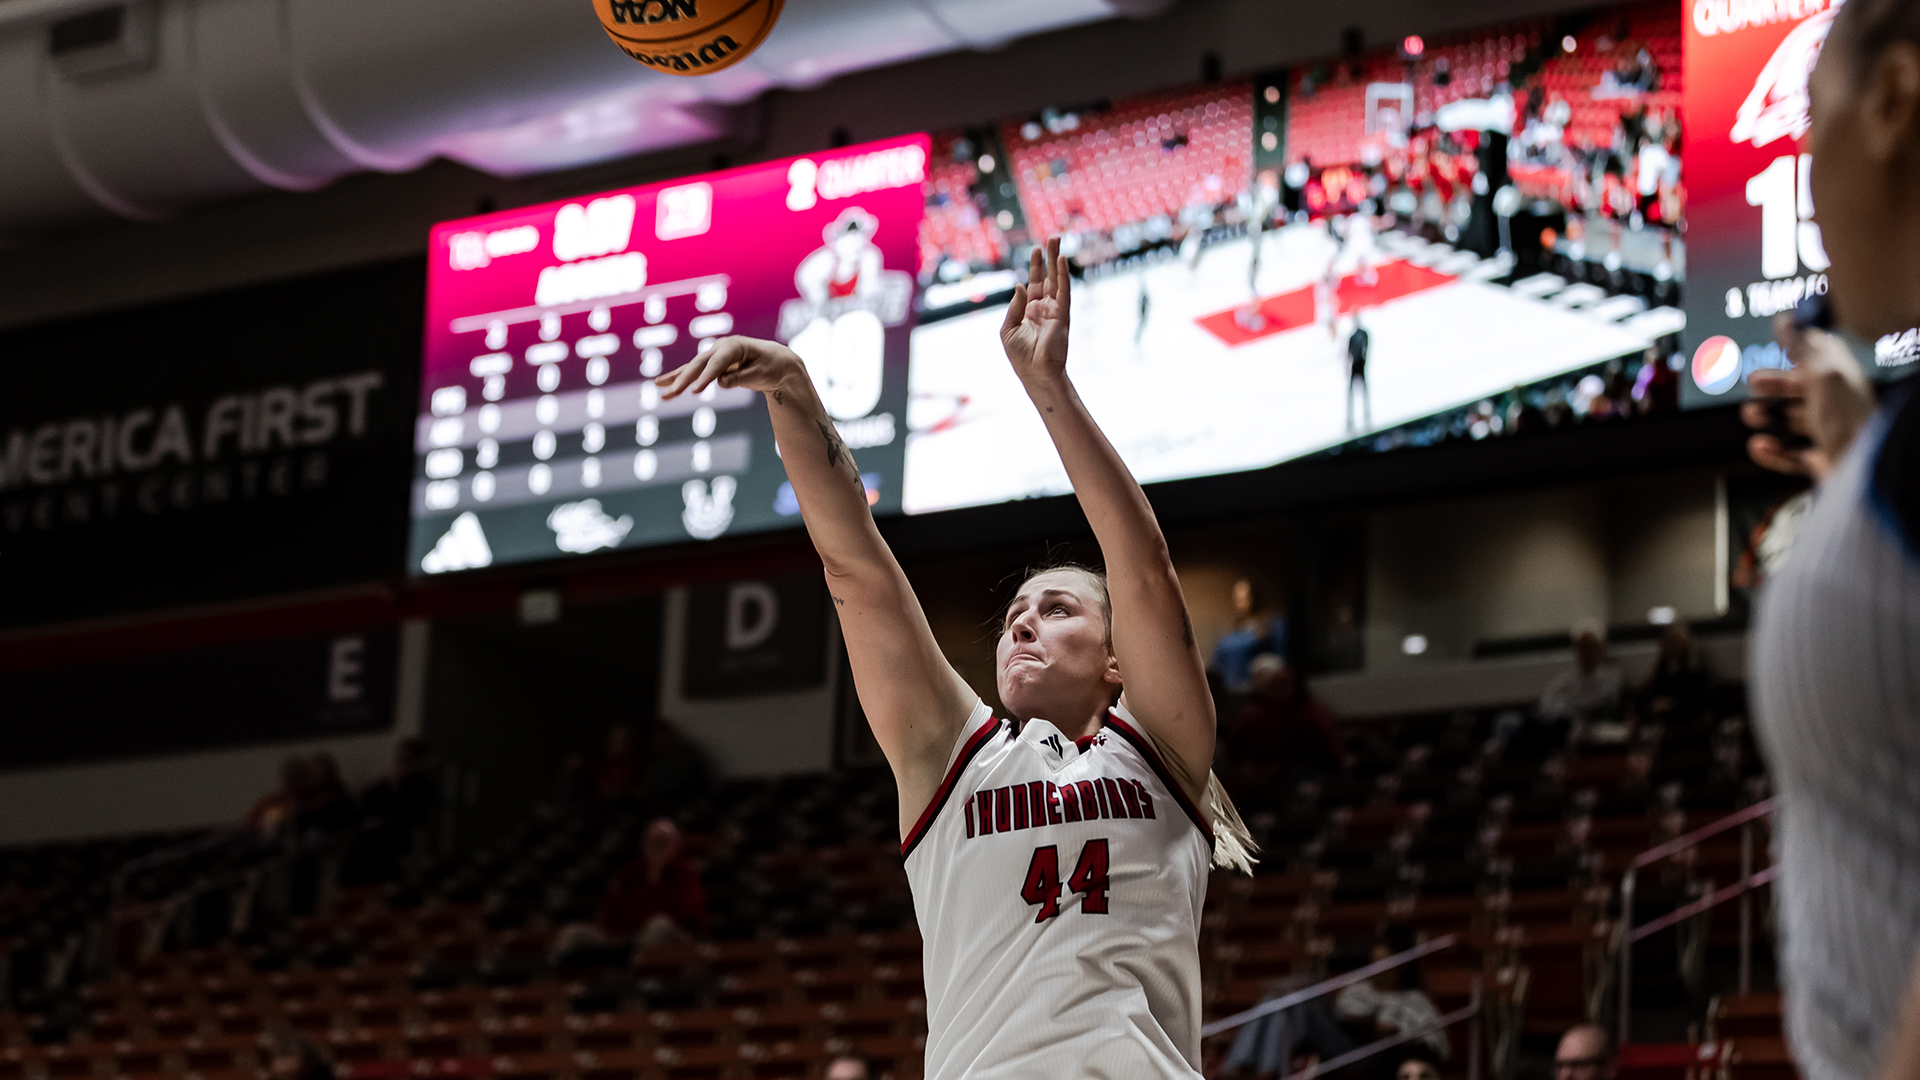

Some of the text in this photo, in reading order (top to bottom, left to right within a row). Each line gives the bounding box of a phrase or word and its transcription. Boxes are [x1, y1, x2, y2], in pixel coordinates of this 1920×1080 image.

[611, 0, 699, 24] NCAA
[616, 35, 739, 71] Wilson
[204, 371, 384, 458] FIRST
[726, 583, 779, 649] D
[329, 637, 365, 700] E
[964, 777, 1156, 839] THUNDERBIRDS
[1020, 838, 1110, 924] 44
